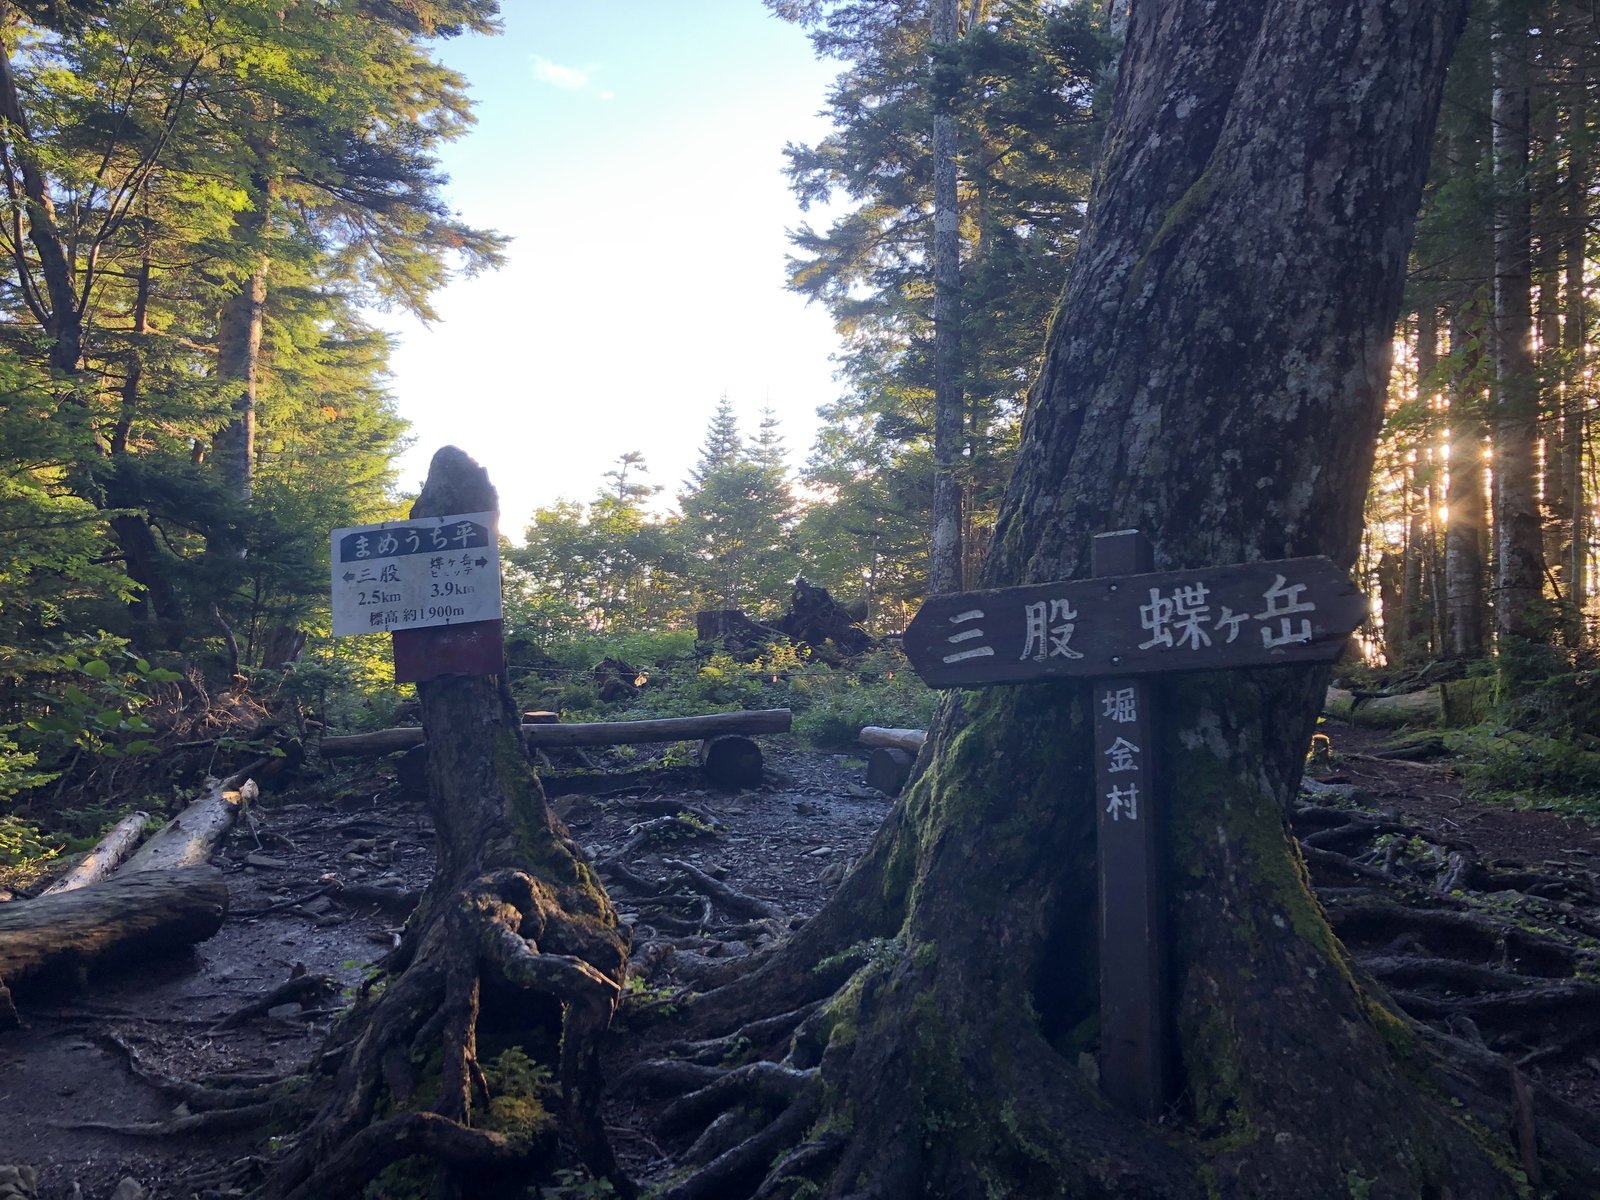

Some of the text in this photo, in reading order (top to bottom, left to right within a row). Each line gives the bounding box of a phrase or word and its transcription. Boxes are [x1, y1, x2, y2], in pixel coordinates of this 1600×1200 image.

[355, 523, 477, 558] まめうち平
[357, 564, 401, 583] 三股
[358, 590, 401, 606] 2.5km
[430, 582, 475, 598] 3.9km
[942, 599, 1085, 664] 三股
[1102, 687, 1141, 822] 堀金村
